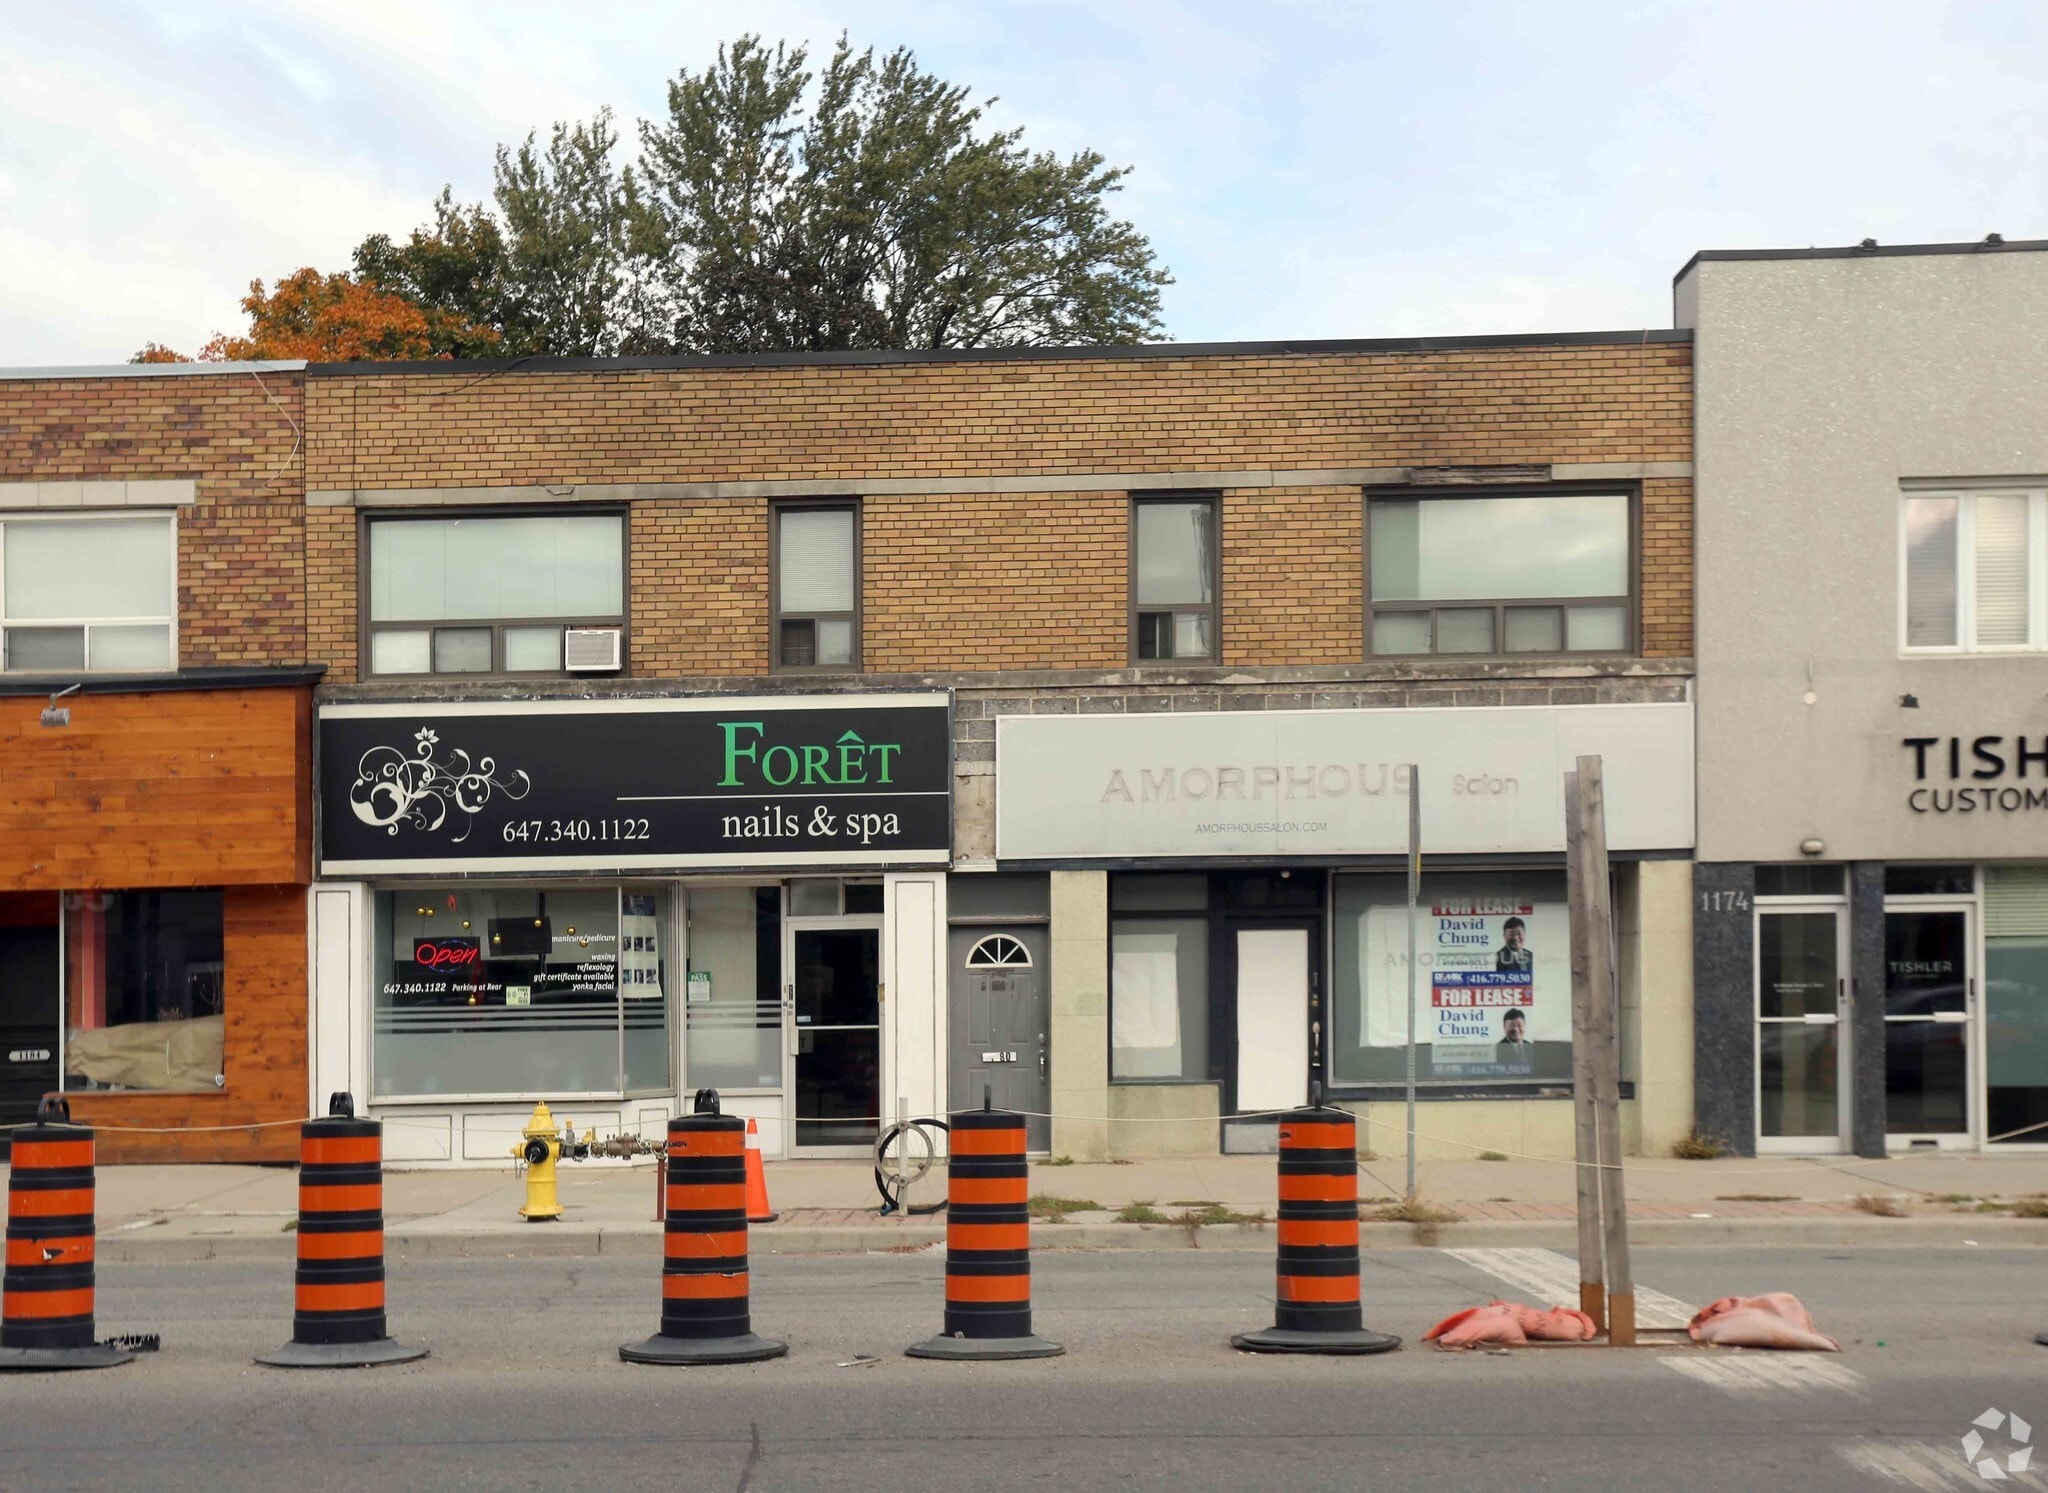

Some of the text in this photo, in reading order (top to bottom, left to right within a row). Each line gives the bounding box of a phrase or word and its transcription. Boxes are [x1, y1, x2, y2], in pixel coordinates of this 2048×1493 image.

[1903, 735, 2048, 780] TISH
[1101, 763, 1412, 802] AMORPHOUS
[1909, 787, 2048, 812] CUSTOM
[502, 819, 651, 843] 647.340.1122
[722, 806, 901, 847] nails & spa
[1195, 821, 1328, 834] AMORPHOUSSALON.COM
[1440, 896, 1523, 914] FOR LEASE
[1701, 891, 1750, 911] 1174
[1440, 918, 1484, 930] David
[551, 934, 616, 943] manicure/pedicure
[1438, 932, 1489, 946] Chung
[416, 944, 478, 967] Open
[591, 952, 616, 962] waxing
[577, 963, 615, 973] reflexology
[1889, 961, 1953, 973] TISHLER
[533, 972, 615, 983] gift certificate available
[690, 974, 708, 982] PASS
[383, 982, 502, 994] 647.340.1122 Parking at Rear
[593, 982, 615, 992] facial
[1440, 988, 1523, 1006] FOR LEASE
[1440, 1010, 1484, 1022] David
[1438, 1024, 1489, 1038] Chung
